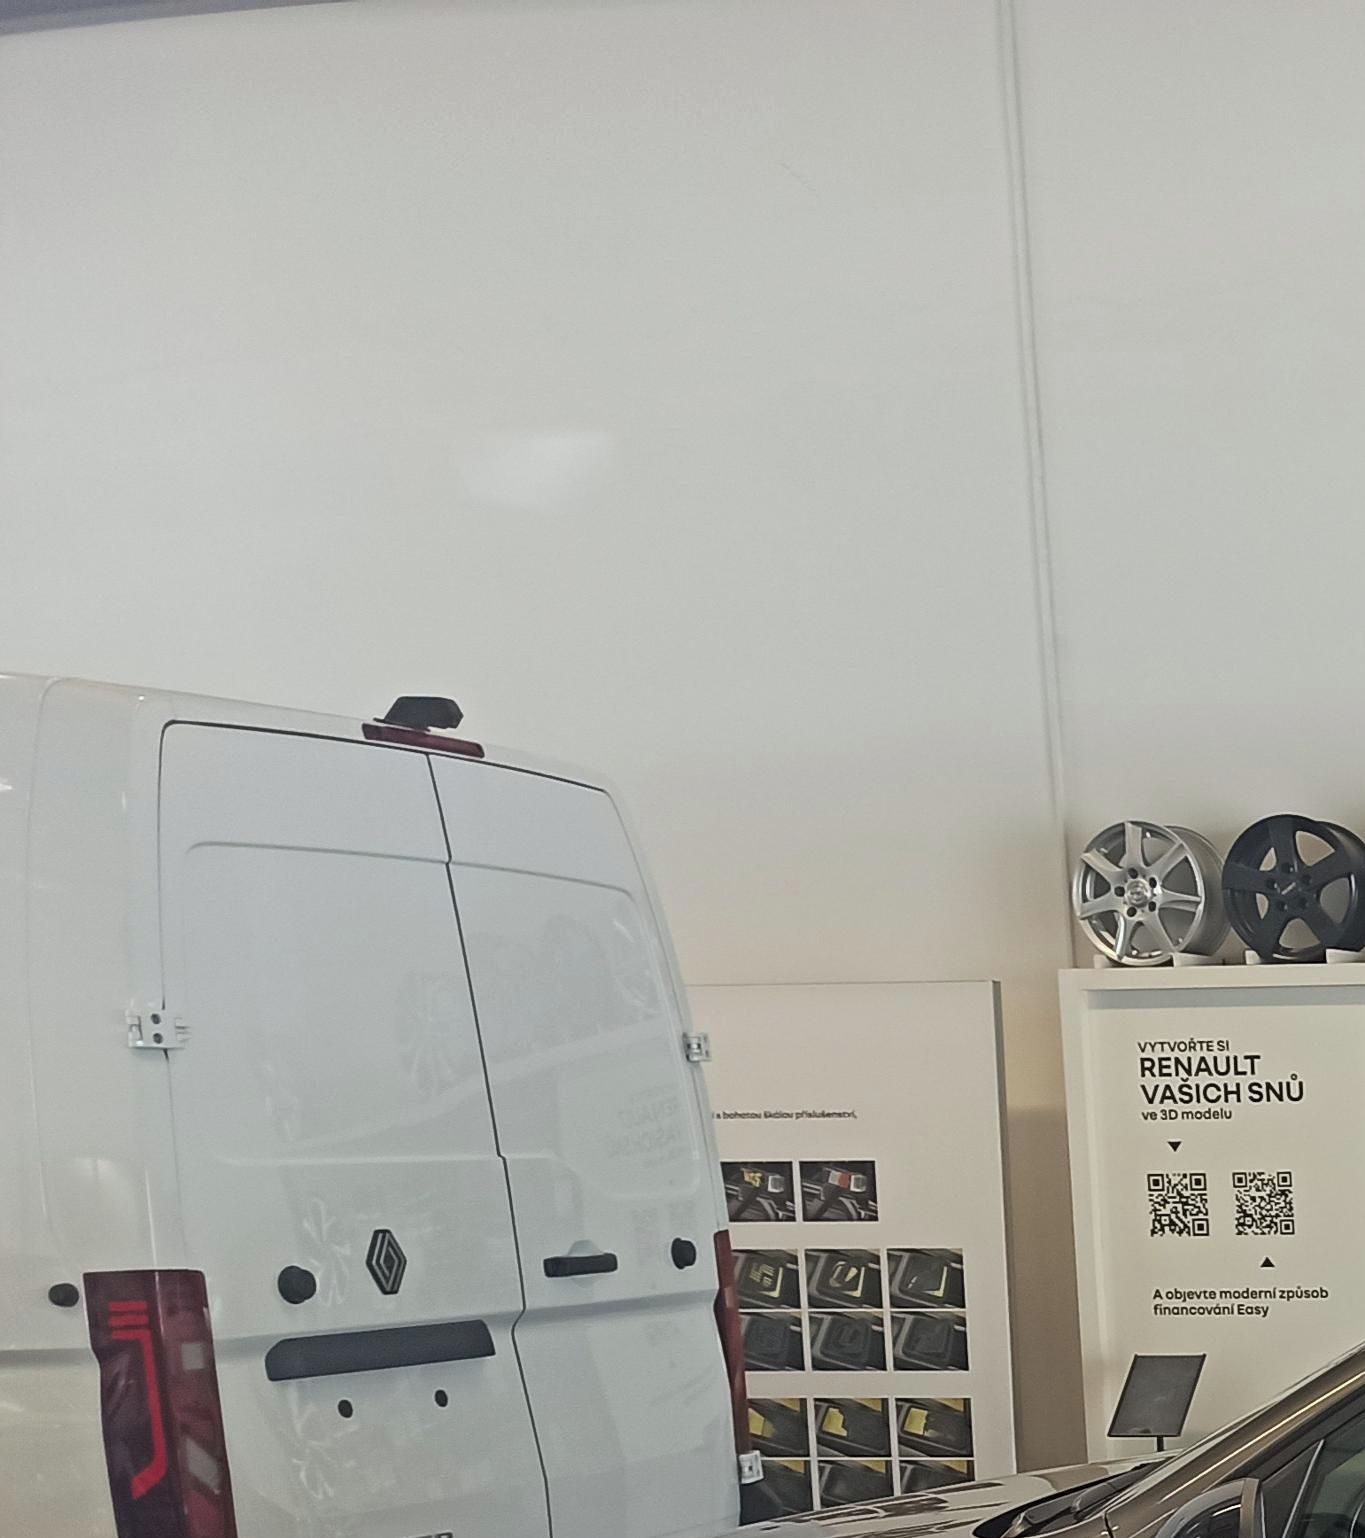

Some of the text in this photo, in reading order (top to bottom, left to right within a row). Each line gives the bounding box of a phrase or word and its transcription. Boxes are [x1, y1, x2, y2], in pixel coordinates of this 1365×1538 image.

[1138, 1037, 1230, 1053] VYTVOŘTE SI
[1139, 1055, 1261, 1078] RENAULT
[1140, 1073, 1304, 1105] VAŠICH SNŮ
[1141, 1108, 1232, 1121] ve 3D modelu
[1152, 1286, 1329, 1303] A objevte moderní způsob
[1153, 1303, 1270, 1318] financování Easy
